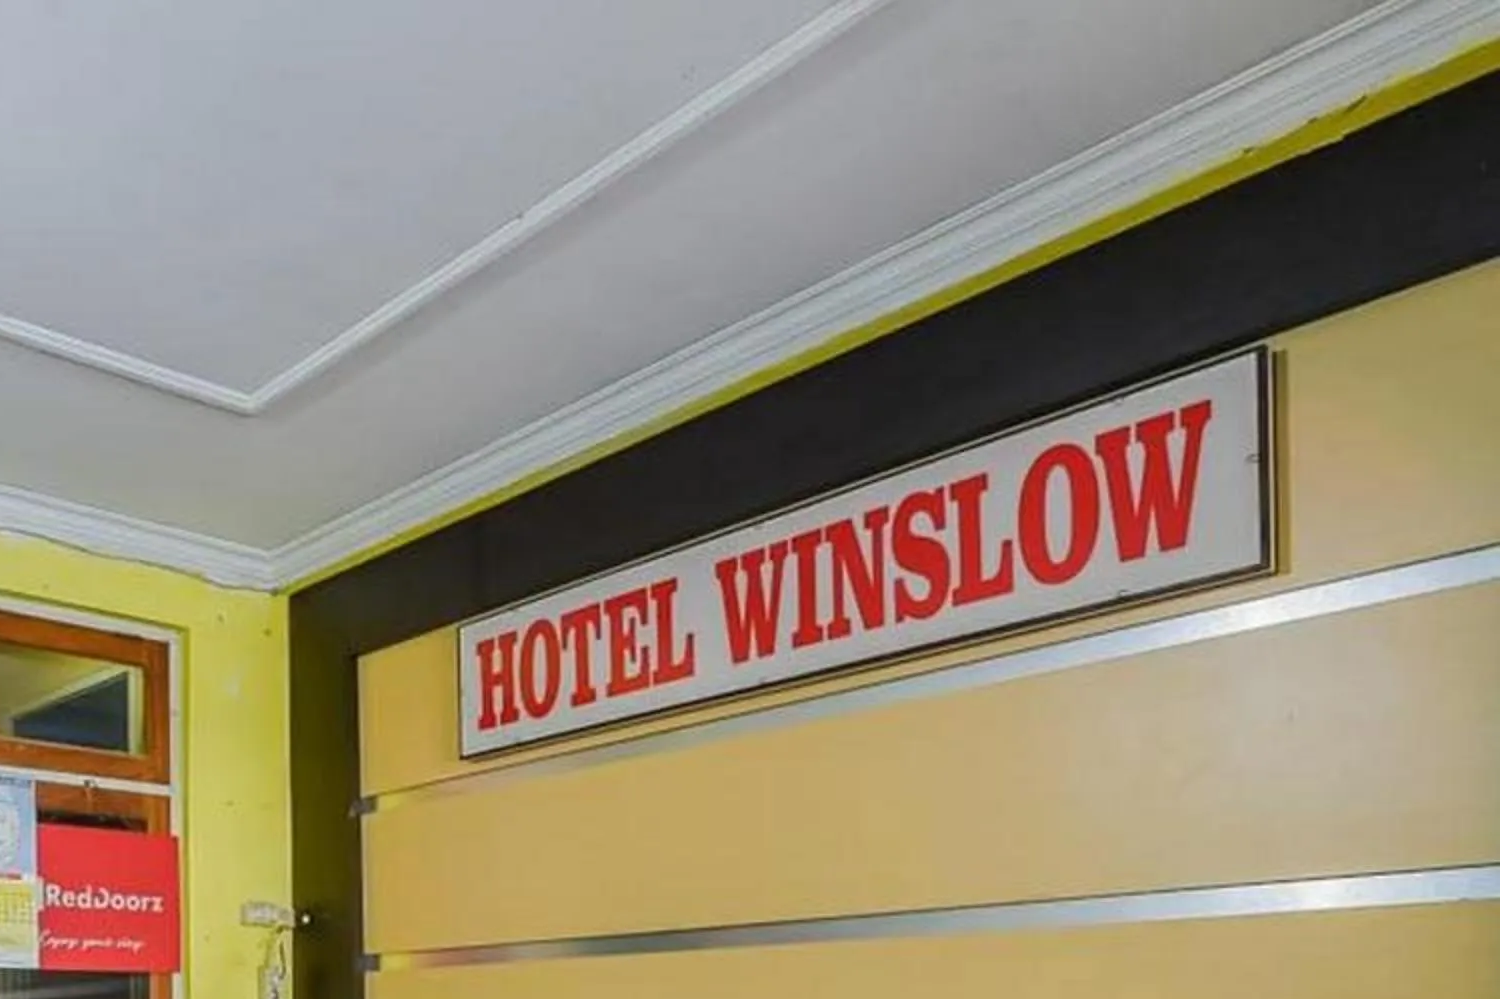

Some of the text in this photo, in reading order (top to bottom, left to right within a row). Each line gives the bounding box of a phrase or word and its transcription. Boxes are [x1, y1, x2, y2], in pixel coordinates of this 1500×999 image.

[476, 400, 1213, 731] HOTEL WINSLOW
[44, 883, 164, 913] RedDoorz
